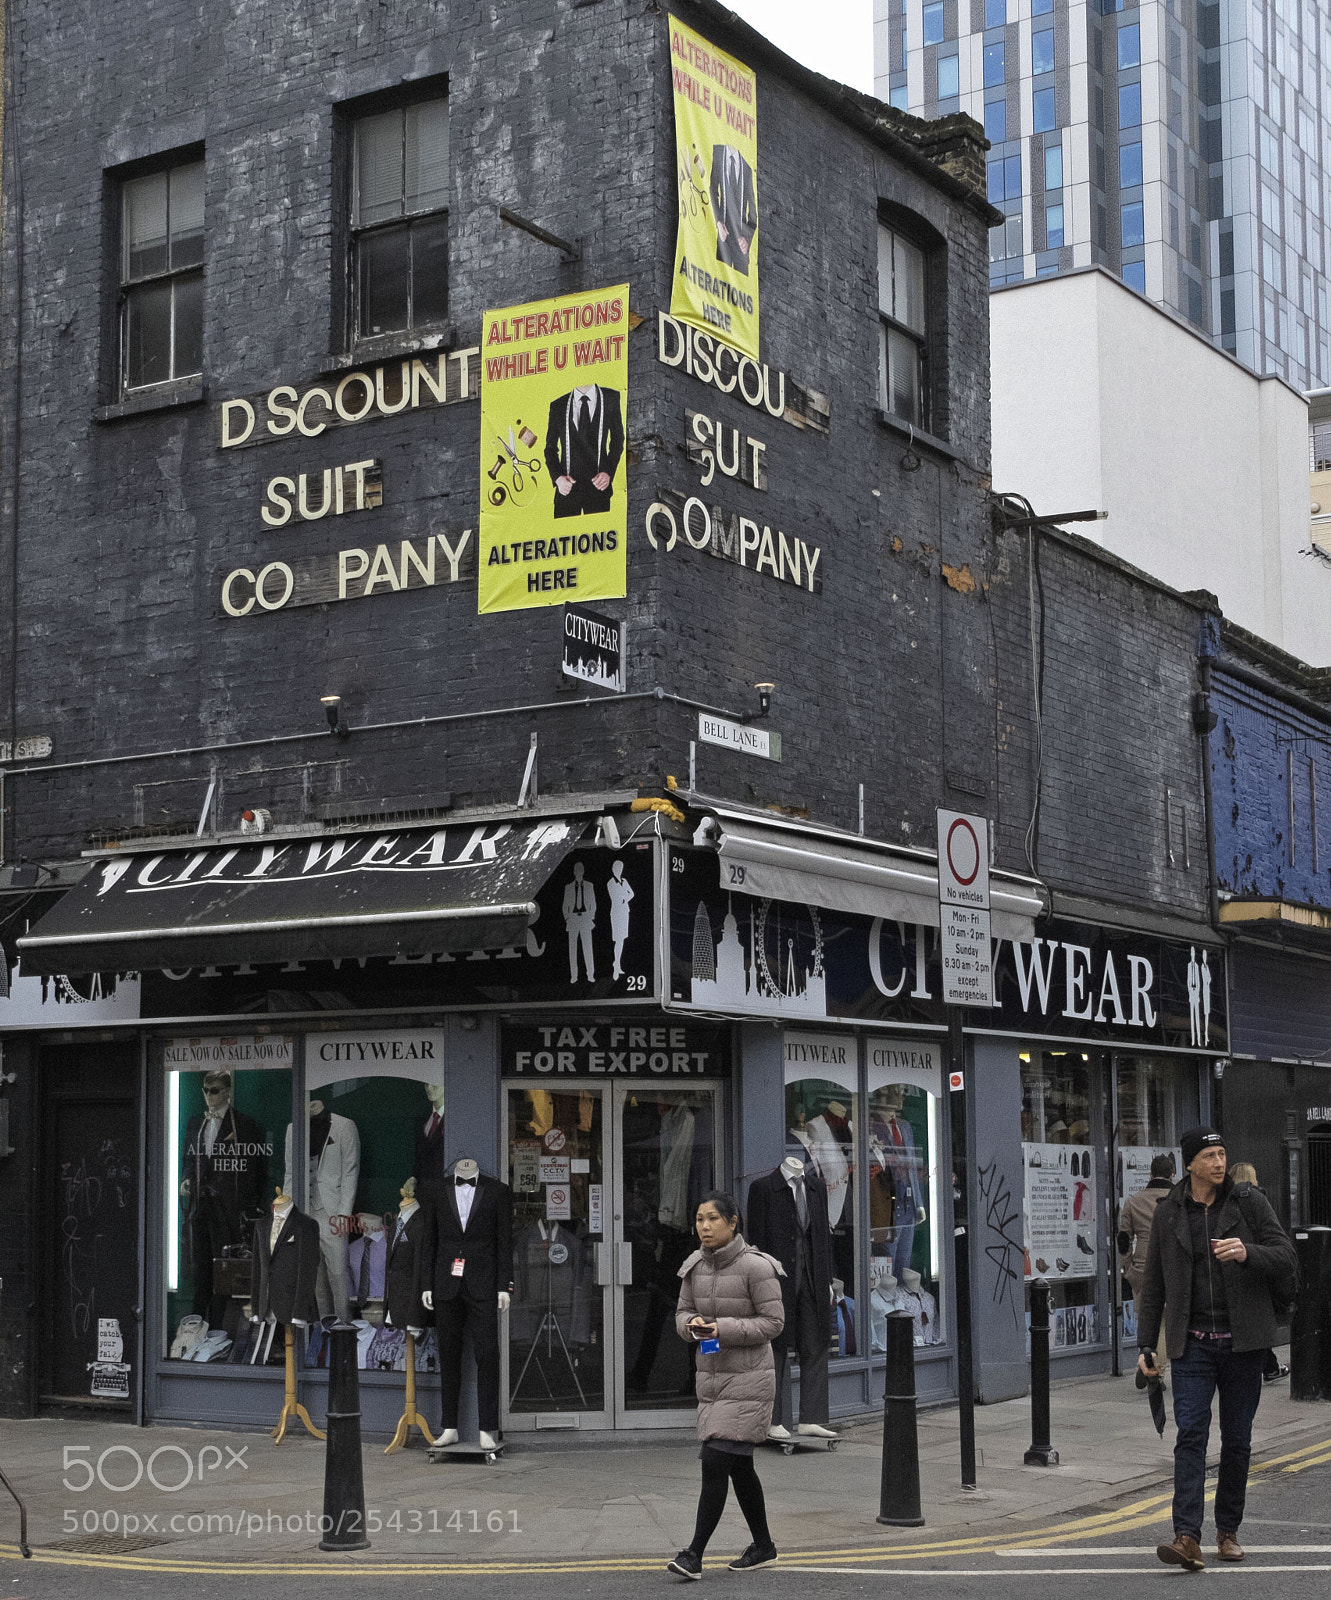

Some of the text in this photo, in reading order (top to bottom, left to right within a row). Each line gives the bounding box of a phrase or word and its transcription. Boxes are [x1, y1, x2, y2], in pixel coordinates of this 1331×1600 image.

[671, 31, 752, 104] ALTERATIONS
[672, 69, 755, 141] WHILE U WAIT
[679, 256, 754, 315] ALTERATIONS
[486, 298, 623, 347] ALTERATIONS
[702, 300, 732, 333] HERE
[485, 335, 625, 382] WHILE U WAIT
[261, 460, 375, 526] SUIT
[488, 530, 617, 566] ALTERATIONS
[527, 567, 578, 593] HERE
[565, 612, 619, 653] CITYWEAR
[704, 720, 728, 740] BELL
[733, 729, 757, 748] LANE
[672, 857, 684, 873] 29
[730, 865, 745, 884] 29
[947, 887, 983, 902] No vehicles
[956, 943, 978, 958] Sunday
[869, 917, 1156, 1028] CIWEAR
[958, 976, 979, 988] except
[627, 976, 646, 991] 29
[949, 990, 988, 1001] emergencies
[539, 1028, 686, 1048] TAX FREE
[166, 1044, 290, 1061] SALE NOW ON SALE NOW ON
[320, 1040, 435, 1062] CITYWEAR
[873, 1049, 933, 1070] CITYWEAR
[516, 1052, 709, 1073] FOR EXPORT
[186, 1142, 274, 1158] ALTERATIONS
[213, 1159, 248, 1173] HERE
